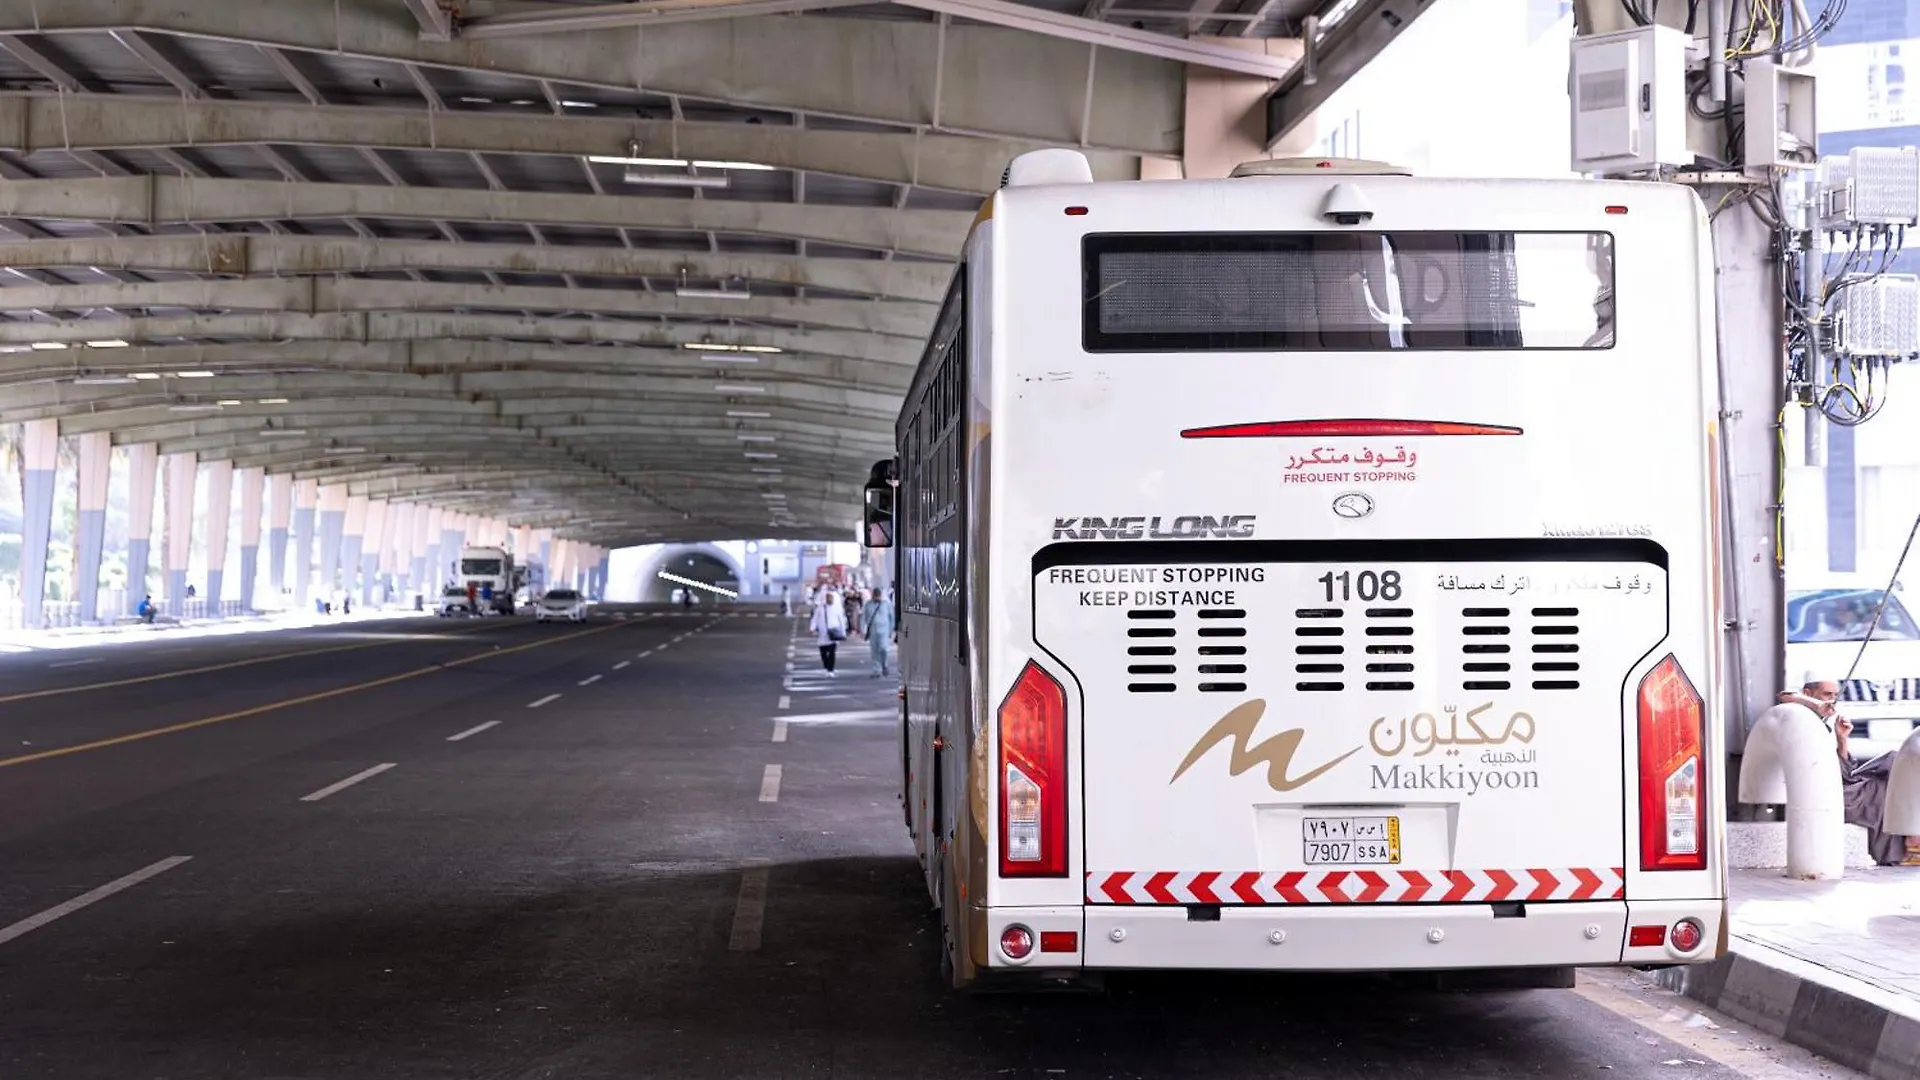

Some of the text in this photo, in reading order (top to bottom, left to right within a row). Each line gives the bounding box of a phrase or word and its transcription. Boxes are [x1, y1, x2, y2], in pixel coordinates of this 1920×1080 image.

[1284, 446, 1417, 470] وقوف متكرر
[1284, 471, 1416, 483] FREQUENT STOPPING
[1052, 515, 1257, 540] KING LONG
[1050, 567, 1265, 584] FREQUENT STOPPING
[1437, 573, 1486, 591] مسافة
[1603, 574, 1652, 594] وقوف
[1318, 570, 1402, 602] 1108
[1079, 590, 1235, 606] KEEP DISTANCE
[1480, 750, 1536, 766] الذهبية
[1370, 764, 1538, 796] Makkiyoon
[1310, 843, 1350, 861] 7907
